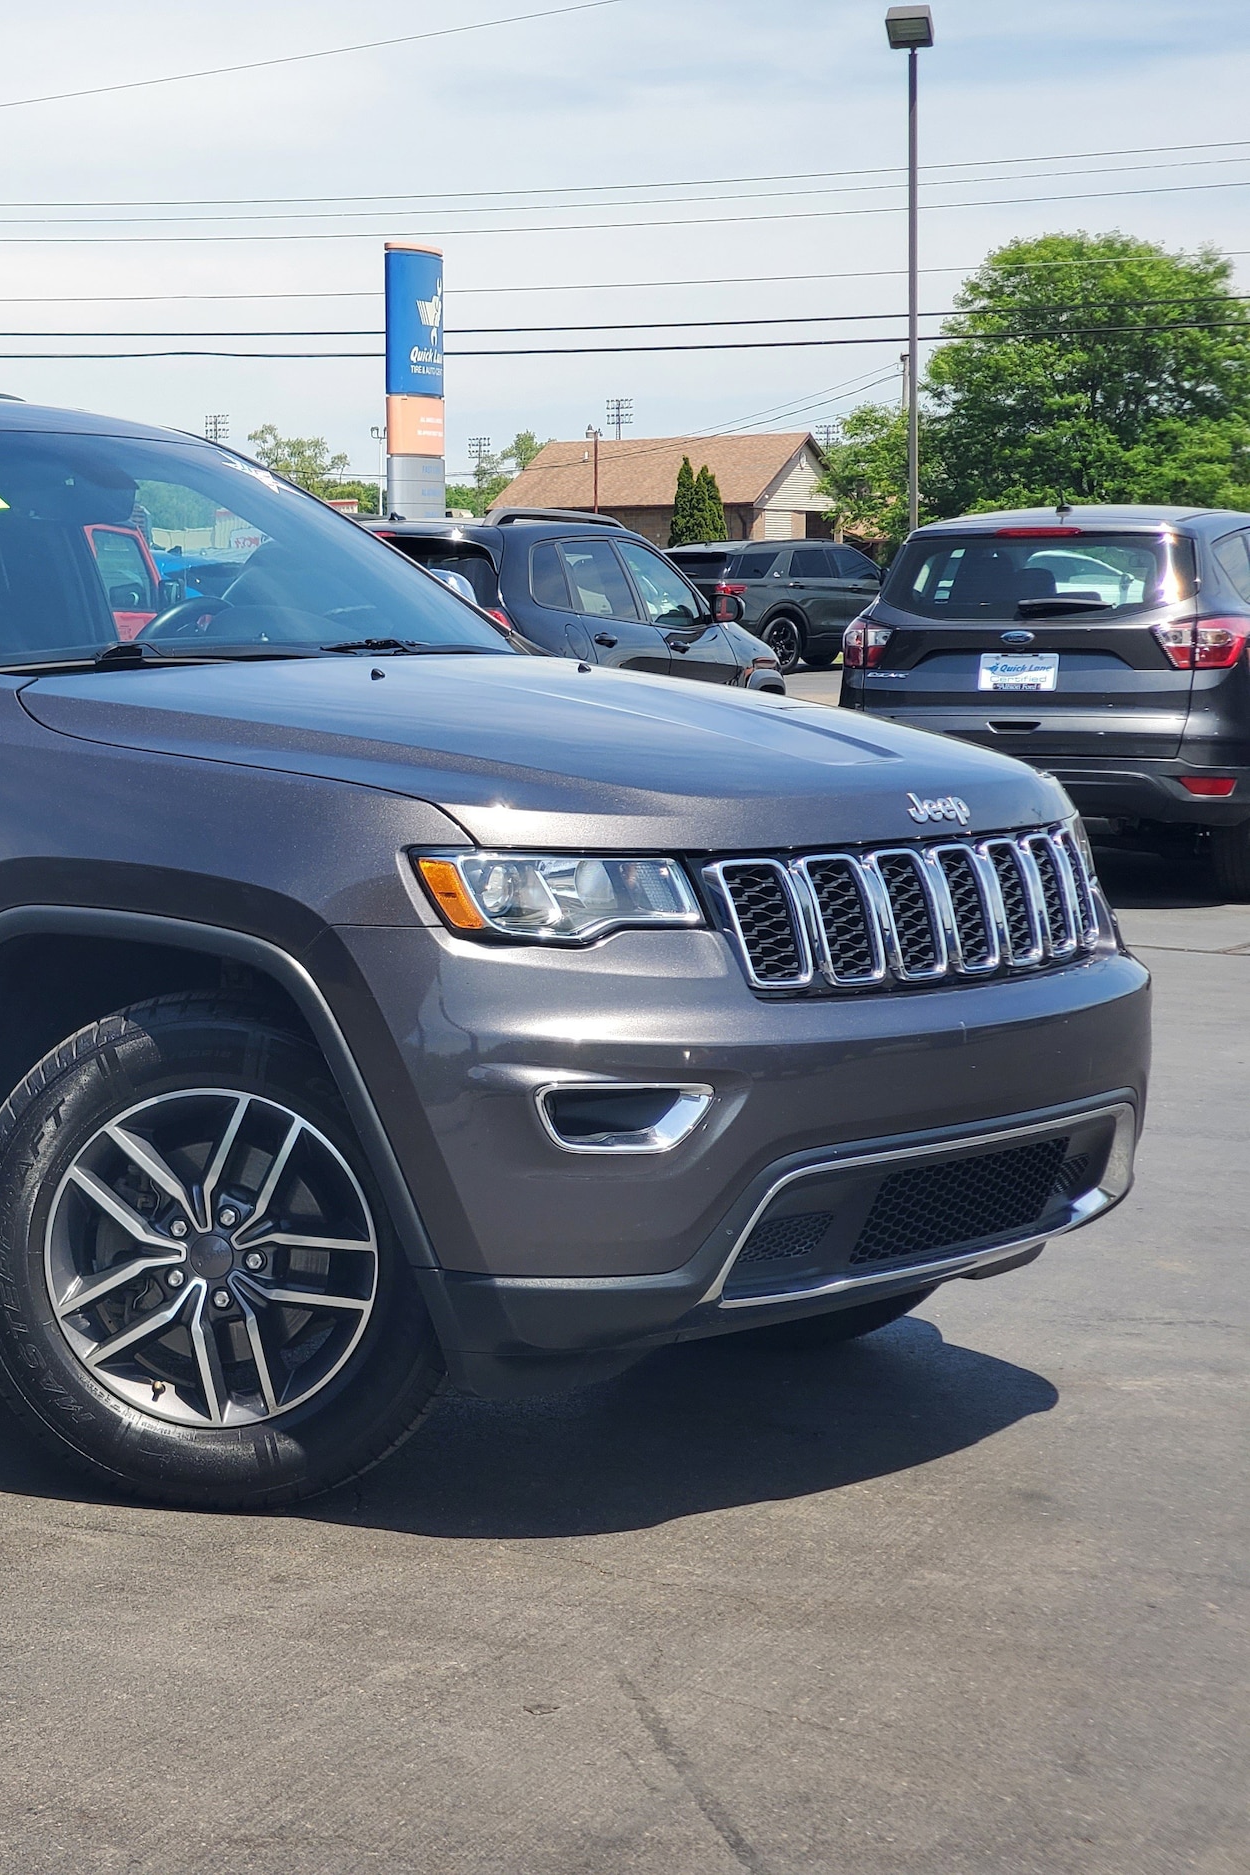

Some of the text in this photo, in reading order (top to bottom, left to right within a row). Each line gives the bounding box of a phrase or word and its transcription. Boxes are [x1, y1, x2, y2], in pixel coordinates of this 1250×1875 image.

[410, 345, 433, 364] Quick
[1000, 664, 1052, 672] Quick Lane
[990, 675, 1047, 683] Certified
[906, 792, 971, 826] Jeep
